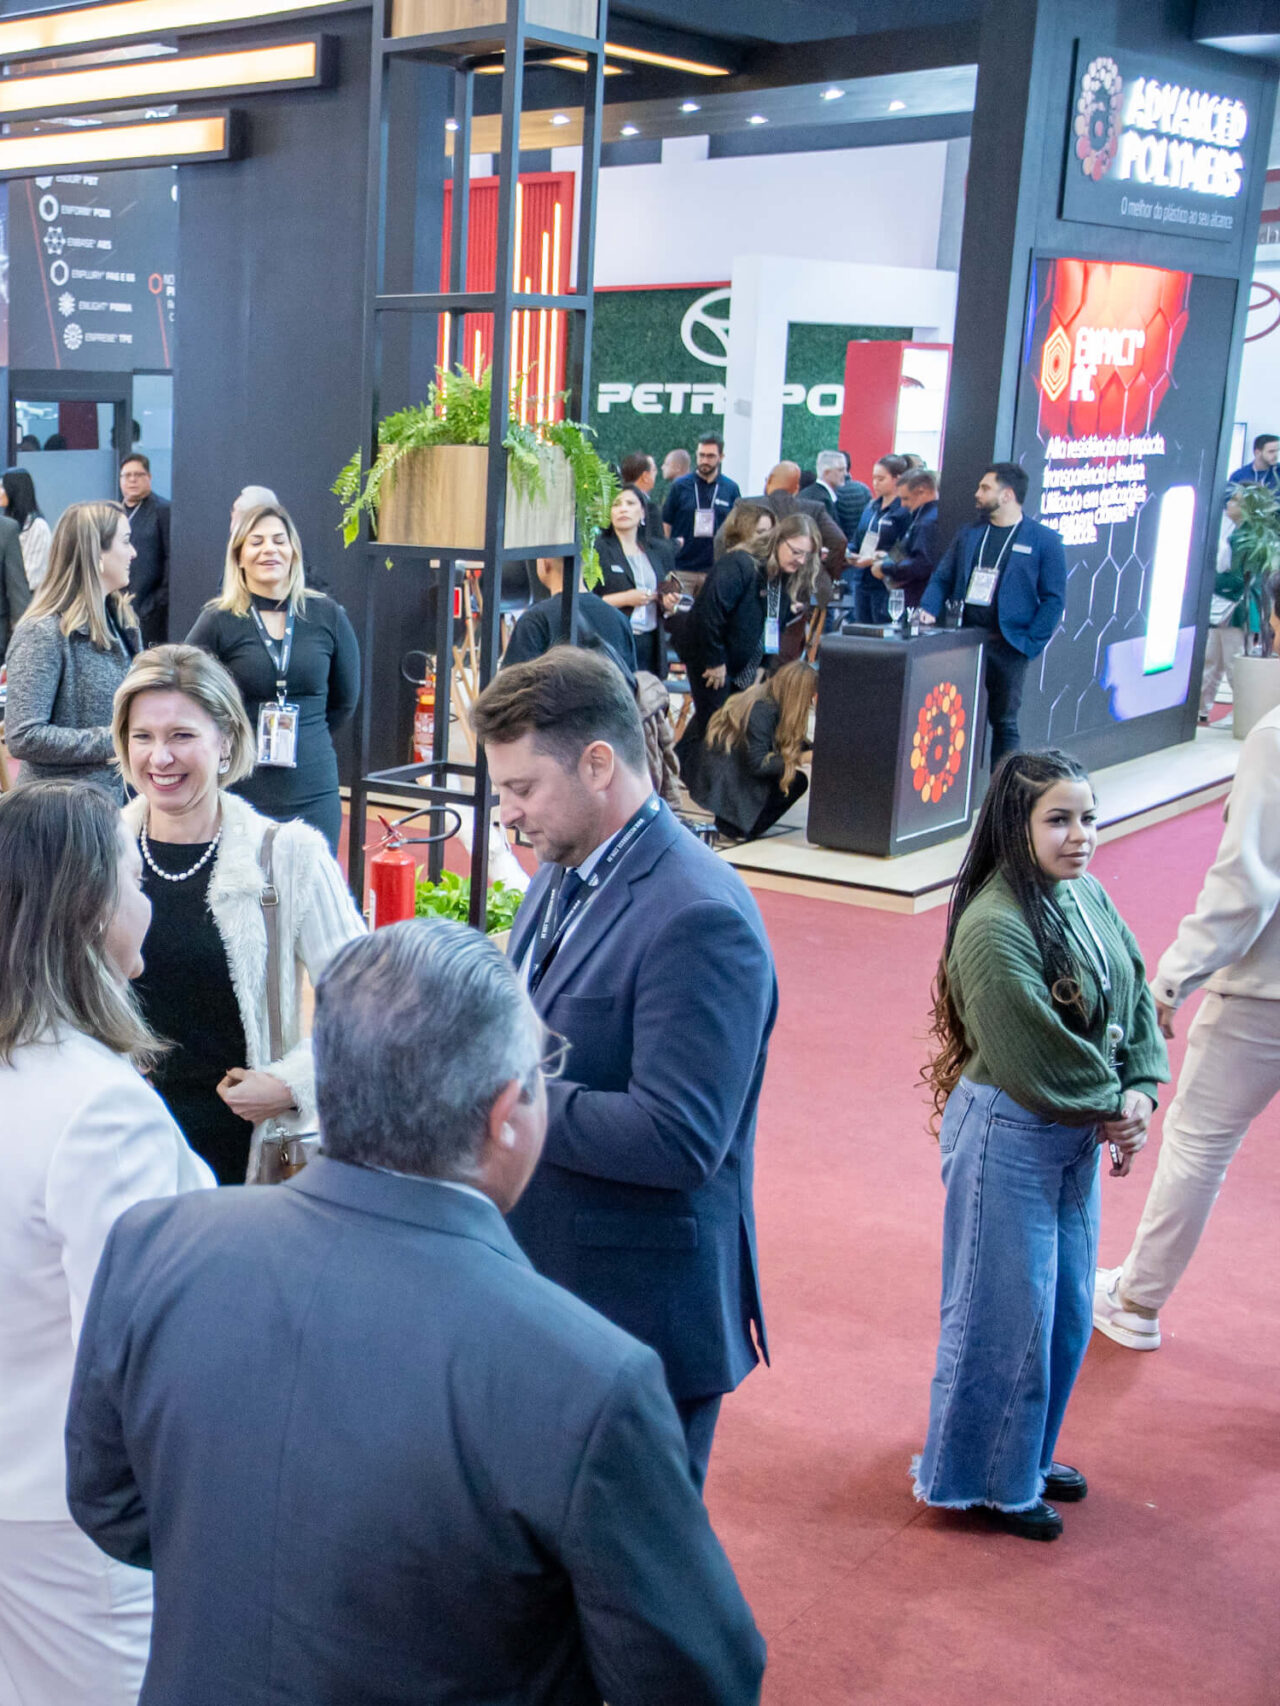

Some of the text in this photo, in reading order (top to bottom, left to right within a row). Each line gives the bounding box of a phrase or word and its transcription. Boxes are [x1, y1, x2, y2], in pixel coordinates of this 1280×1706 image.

[1125, 76, 1248, 147] ADVANCED
[1120, 129, 1245, 197] POLYMERS
[1120, 196, 1128, 215] O
[1128, 199, 1153, 218] melhor
[1153, 202, 1163, 220] do
[1189, 210, 1197, 223] ao
[1198, 212, 1210, 226] seu
[1210, 213, 1234, 229] alcance
[1070, 364, 1097, 402] PC
